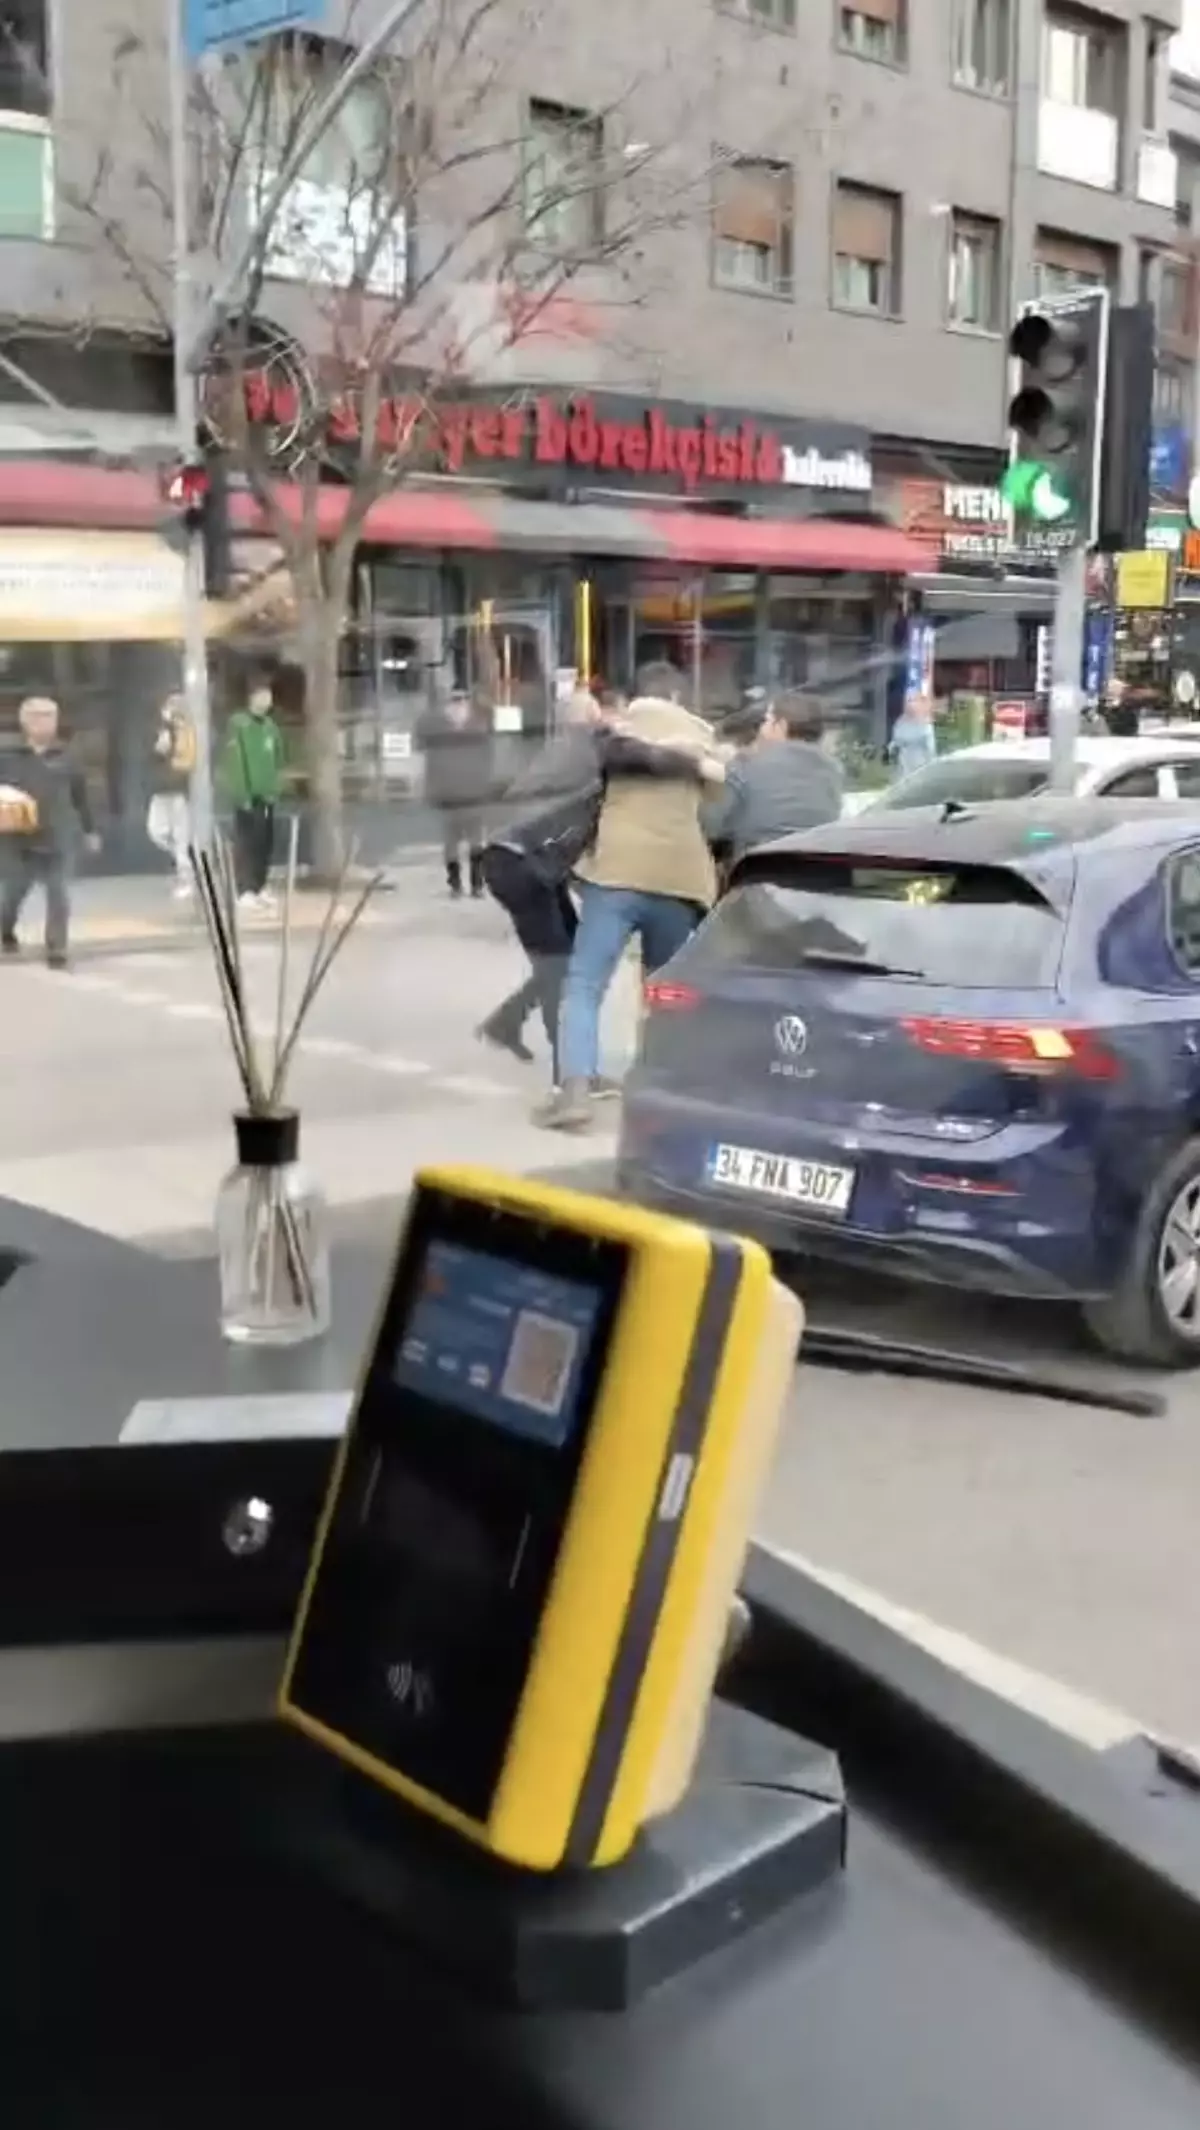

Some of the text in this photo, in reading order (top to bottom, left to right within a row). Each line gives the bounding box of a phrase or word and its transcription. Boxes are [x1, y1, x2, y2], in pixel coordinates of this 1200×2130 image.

[718, 1149, 844, 1201] 34 FNA 907
